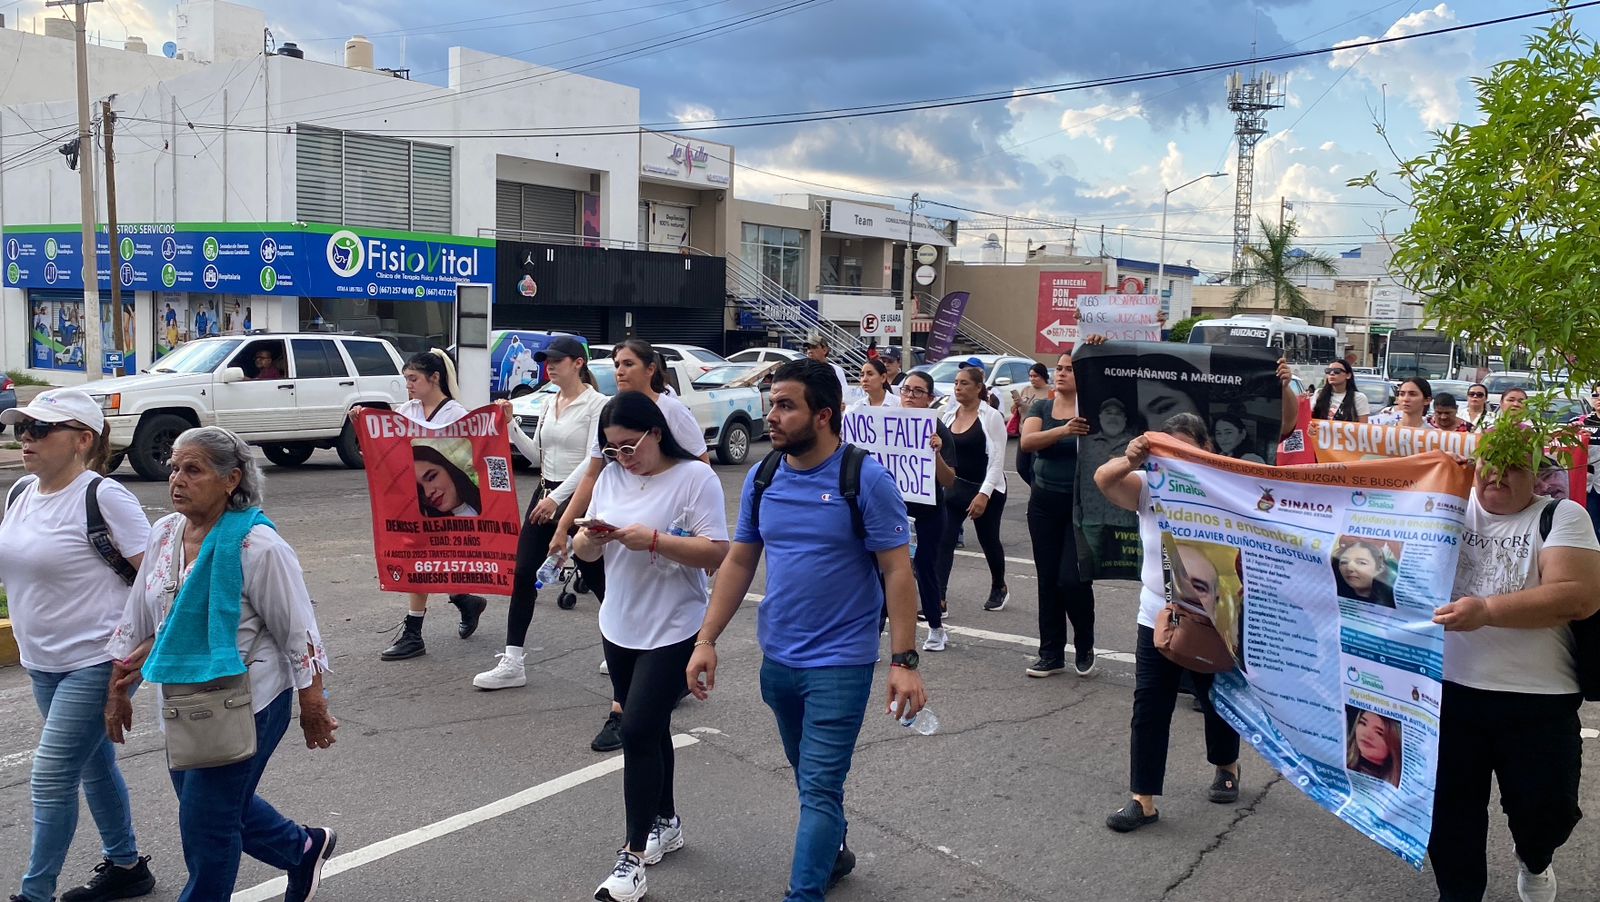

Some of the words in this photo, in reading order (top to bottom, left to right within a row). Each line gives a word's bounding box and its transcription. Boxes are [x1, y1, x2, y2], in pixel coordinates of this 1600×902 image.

[854, 214, 873, 227] Team
[103, 224, 137, 234] NSTROS
[139, 224, 175, 234] SERVICIOS
[368, 240, 477, 277] FisioVital
[402, 273, 420, 281] Terapia
[1052, 278, 1087, 286] CARNICERÍA
[379, 285, 391, 295] (667)
[392, 286, 401, 294] 257
[426, 288, 438, 296] (667)
[1052, 288, 1068, 298] DON
[1052, 298, 1078, 307] PONCH
[1079, 313, 1094, 324] NO
[1096, 312, 1108, 323] SE
[1230, 328, 1267, 339] HUIZACHES
[1104, 367, 1178, 380] ACOMPÁÑANOS
[1180, 372, 1187, 380] A
[1190, 372, 1242, 386] MARCHAR
[844, 413, 877, 444] NOS
[884, 417, 935, 449] FALTA
[1318, 420, 1477, 459] DESAPARECIDA
[1285, 471, 1298, 480] SE
[1351, 476, 1367, 485] SE
[1370, 477, 1417, 489] BUSCAN
[1168, 479, 1207, 498] Sinaloa
[1279, 498, 1333, 514] SINALOA
[1367, 500, 1394, 509] Sinaloa
[385, 519, 420, 534] DENISSE
[422, 519, 475, 533] ALEJANDRA
[477, 519, 500, 533] AVITIA
[1154, 502, 1220, 526] Aúdanos
[1224, 518, 1232, 529] a
[1311, 538, 1322, 550] a
[429, 536, 451, 546] EDAD:
[452, 536, 462, 546] 29
[463, 534, 481, 546] AÑOS
[1347, 525, 1391, 538] PATRICIA
[1393, 530, 1419, 541] VILLA
[1420, 532, 1457, 546] OLIVAS
[1193, 529, 1224, 542] JAVIER
[1226, 532, 1272, 552] QUIÑONEZ
[1274, 545, 1323, 565] GASTELUM
[411, 550, 428, 558] 2025
[428, 550, 457, 559] TRAYECTO
[414, 561, 499, 574] 6671571930
[407, 572, 449, 584] SABUESOS
[496, 574, 510, 586] A.C.
[1348, 698, 1373, 711] DENISSE
[1373, 706, 1408, 721] ALEJANDRA
